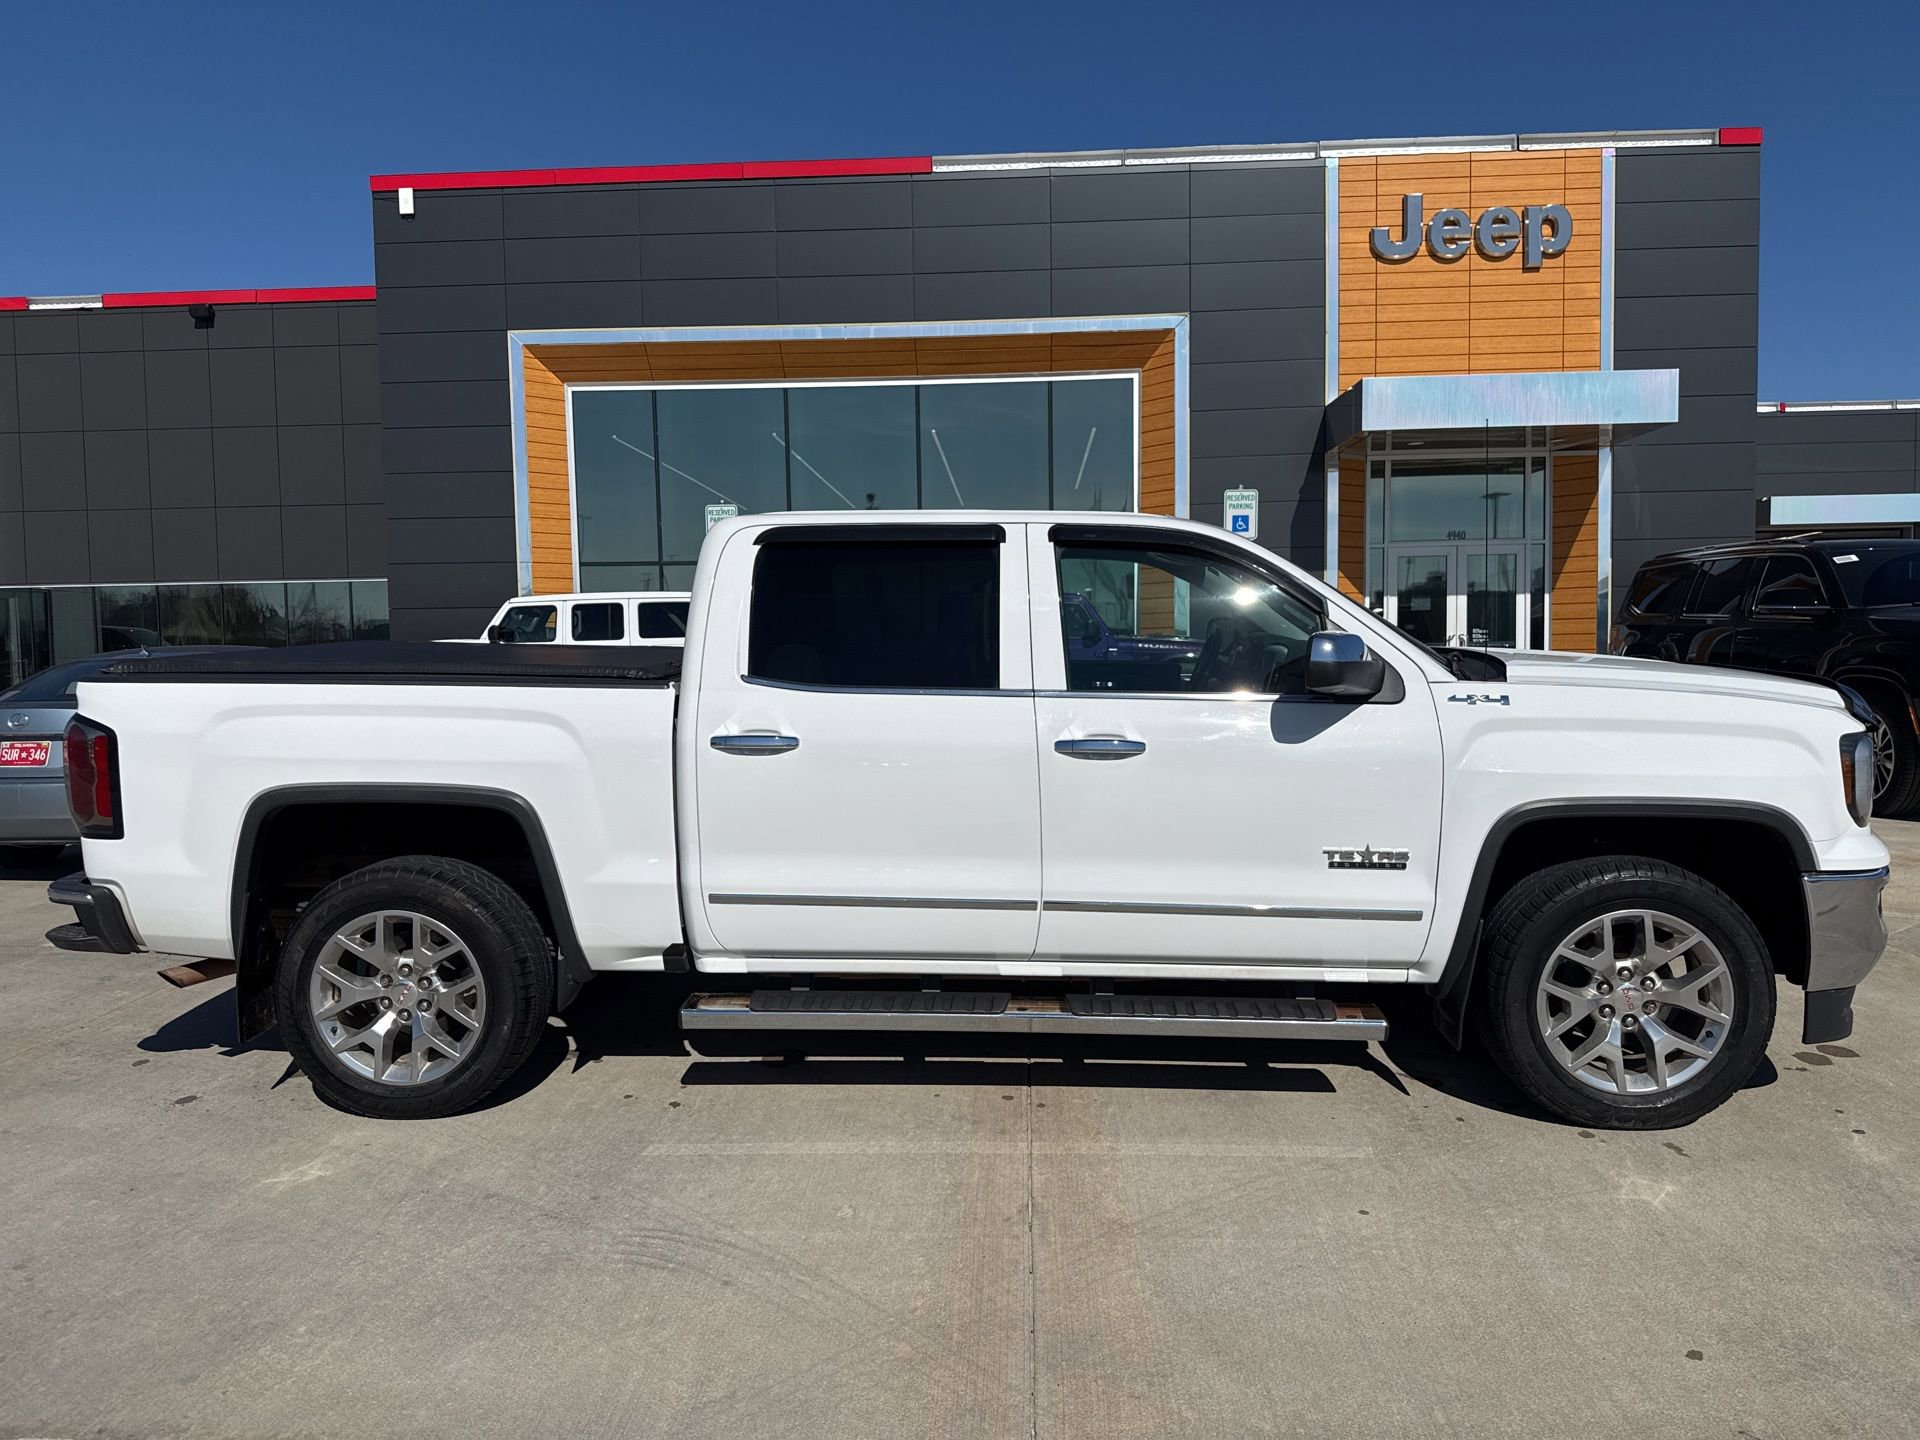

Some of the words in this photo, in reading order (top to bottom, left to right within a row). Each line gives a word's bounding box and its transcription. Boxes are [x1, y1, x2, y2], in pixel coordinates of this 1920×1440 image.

[1369, 192, 1573, 270] Jeep
[1228, 502, 1254, 510] PARKING
[708, 508, 735, 516] RESERVED
[1, 748, 20, 761] SUR
[27, 748, 47, 761] 346
